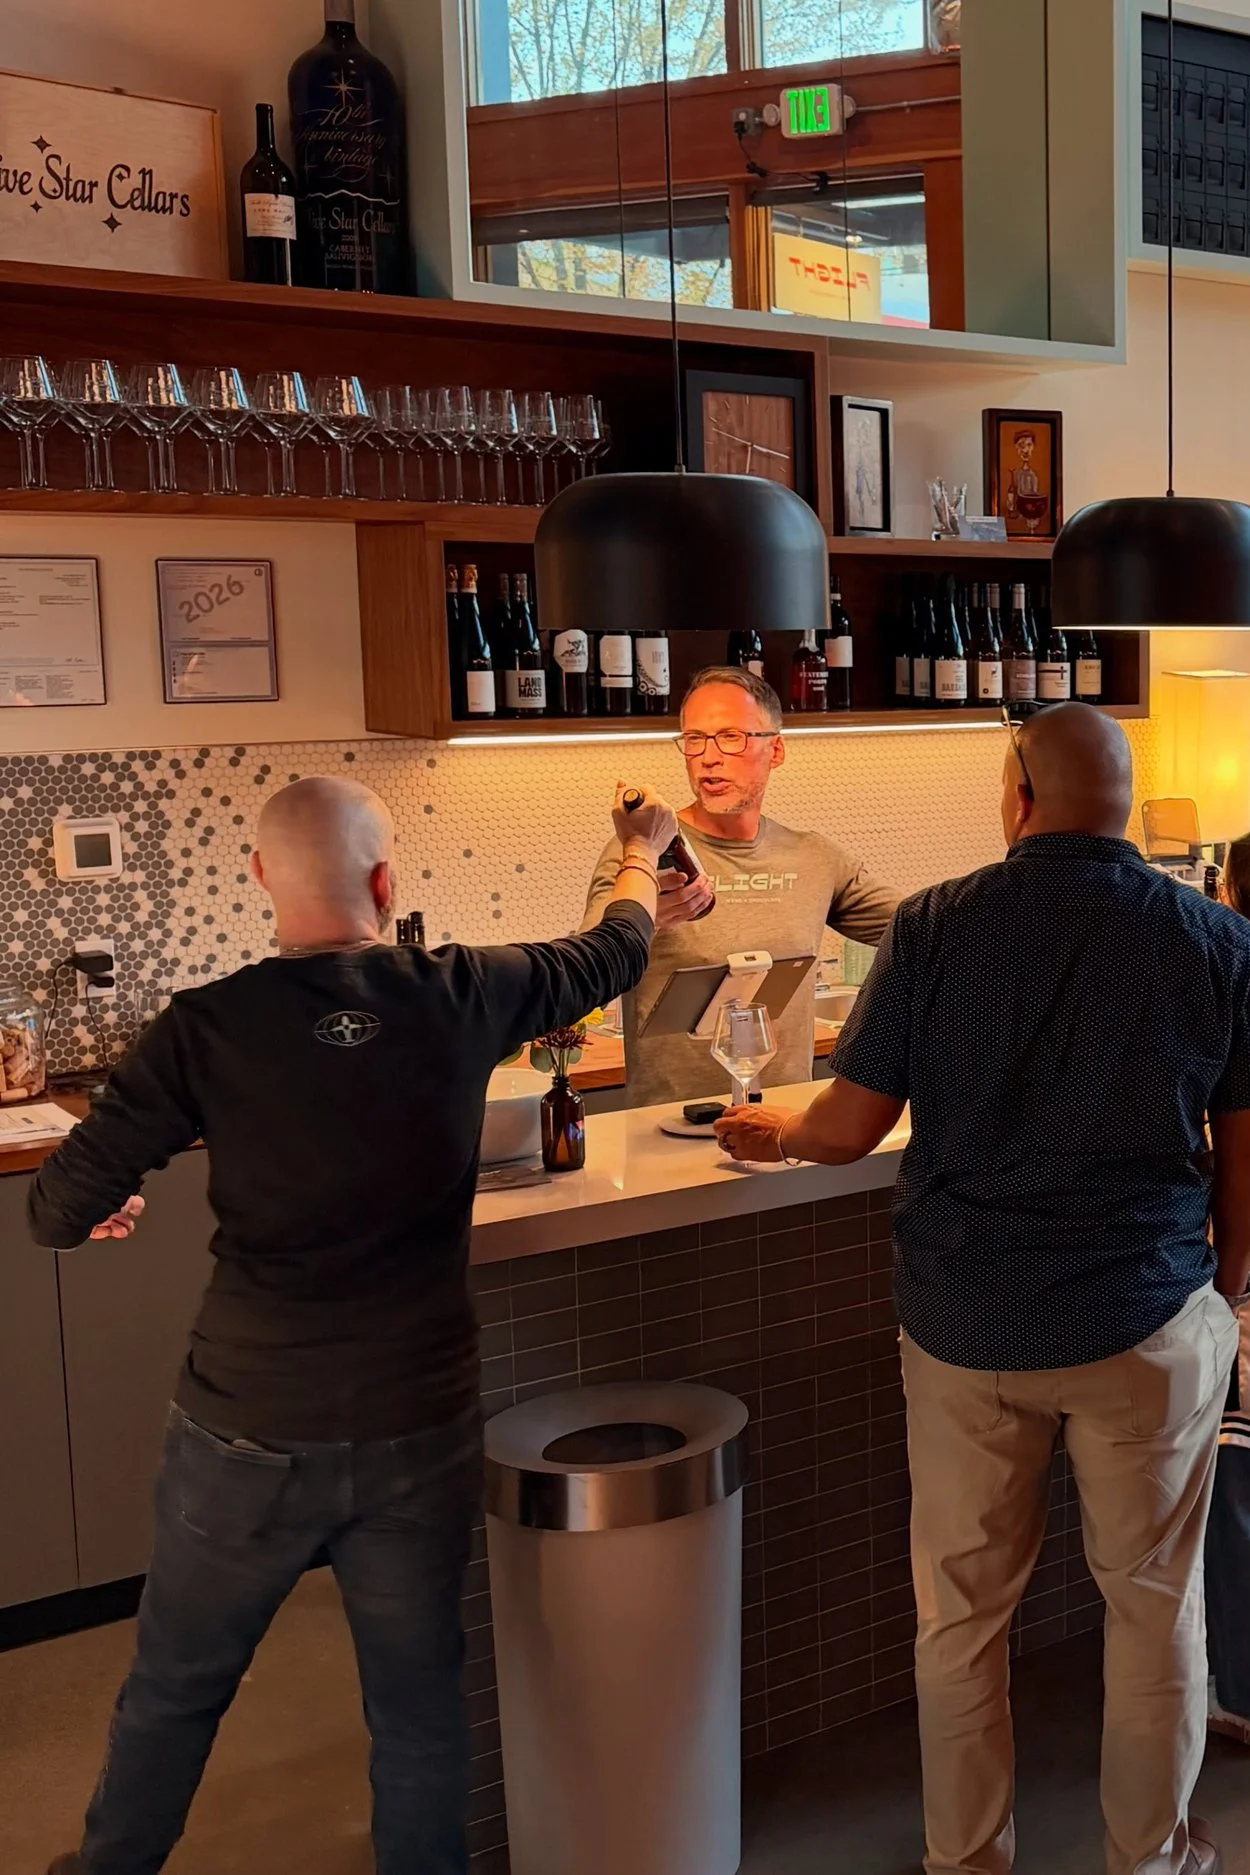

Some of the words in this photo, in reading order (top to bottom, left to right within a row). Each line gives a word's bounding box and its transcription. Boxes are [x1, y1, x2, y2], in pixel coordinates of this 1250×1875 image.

[39, 153, 98, 204] Star
[107, 164, 191, 217] Cellars
[329, 207, 358, 229] Star
[179, 574, 244, 624] 2026
